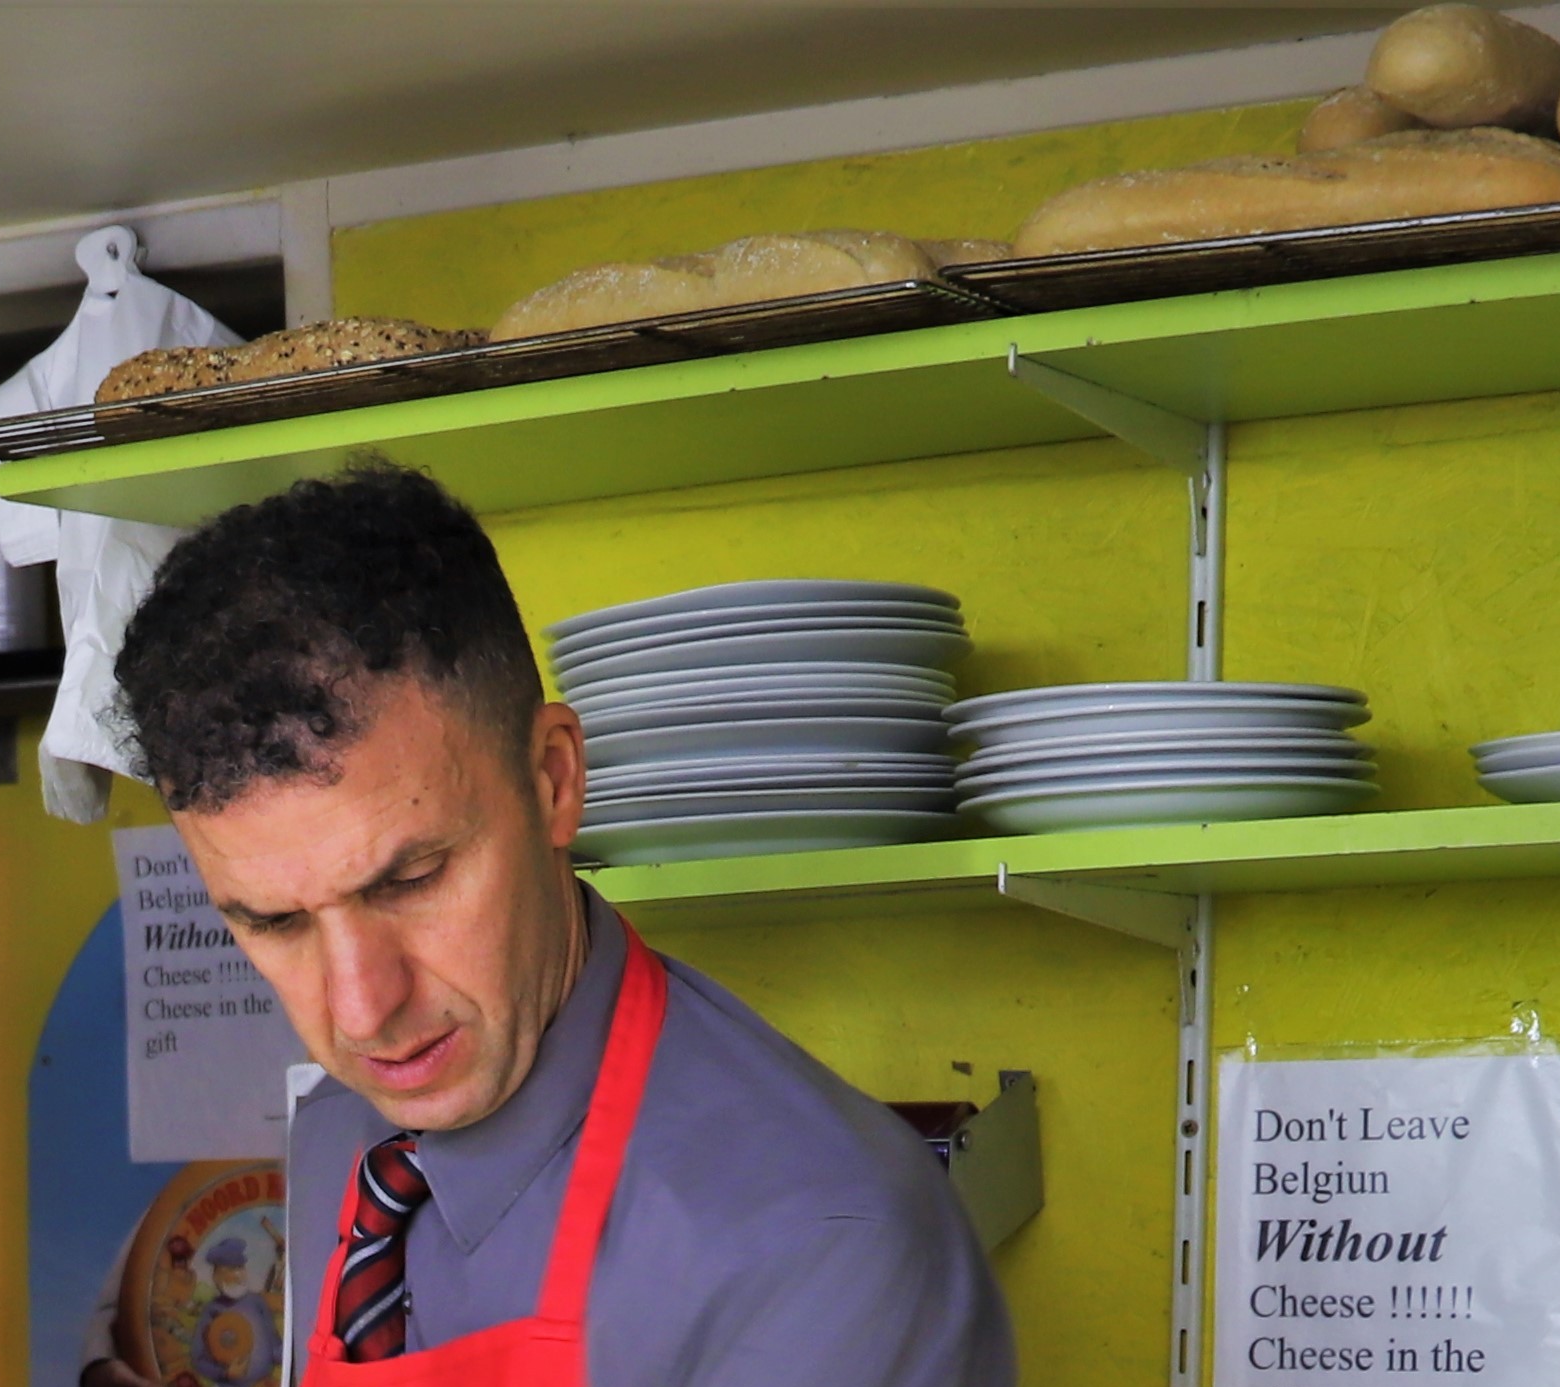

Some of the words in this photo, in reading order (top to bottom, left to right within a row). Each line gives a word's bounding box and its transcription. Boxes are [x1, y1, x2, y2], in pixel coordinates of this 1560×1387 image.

[135, 856, 190, 878] Don't
[144, 965, 211, 988] Cheese
[145, 1000, 211, 1021] Cheese
[219, 1001, 236, 1017] in
[244, 996, 272, 1015] the
[146, 1031, 178, 1059] gift
[1254, 1109, 1348, 1142] Don't
[1360, 1108, 1471, 1141] Leave
[1253, 1162, 1390, 1202] Belgiun
[1255, 1219, 1448, 1264] Without
[1250, 1285, 1375, 1319] Cheese
[1390, 1285, 1475, 1319] !!!!!!
[1248, 1337, 1373, 1372] Cheese
[1385, 1339, 1418, 1373] in
[1432, 1339, 1485, 1373] the
